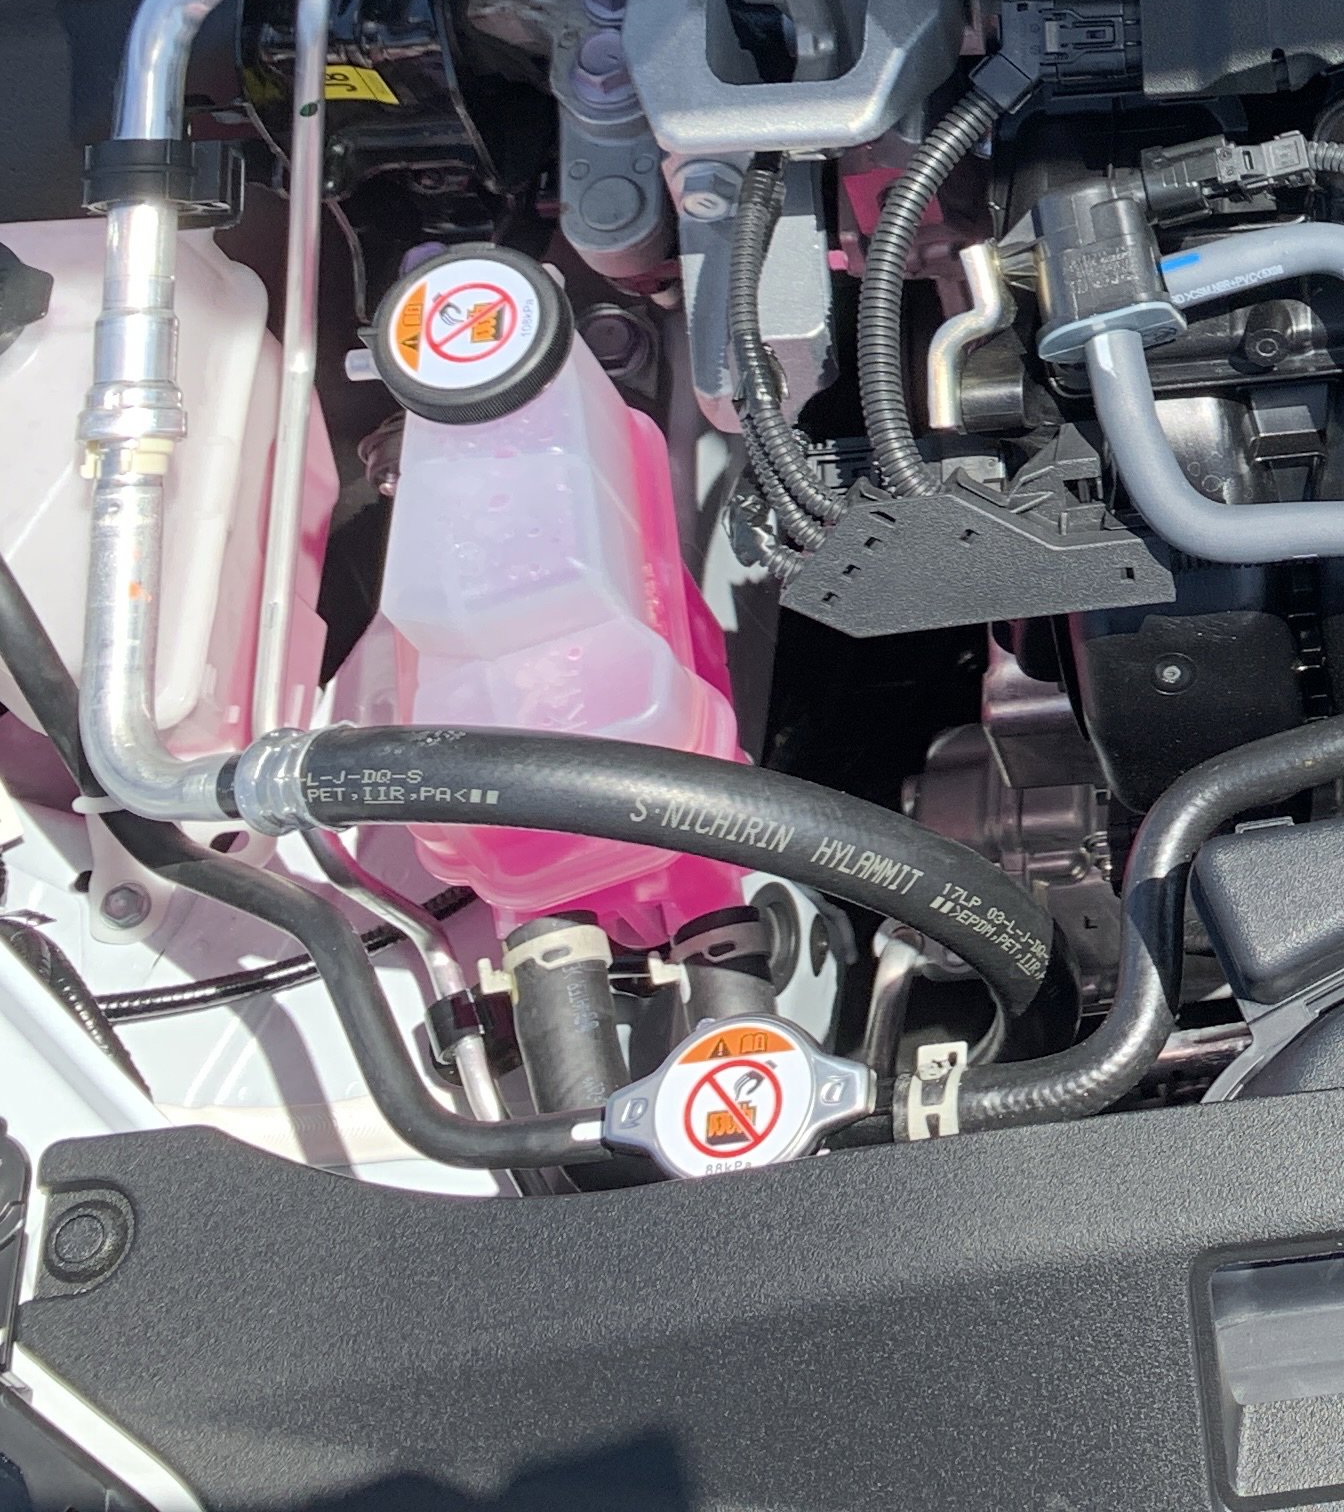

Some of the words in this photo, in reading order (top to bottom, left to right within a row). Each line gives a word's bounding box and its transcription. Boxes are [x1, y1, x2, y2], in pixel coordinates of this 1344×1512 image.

[810, 837, 925, 895] HYLAMMIT
[943, 882, 983, 908] 17LP
[704, 1160, 752, 1176] 88kPa
